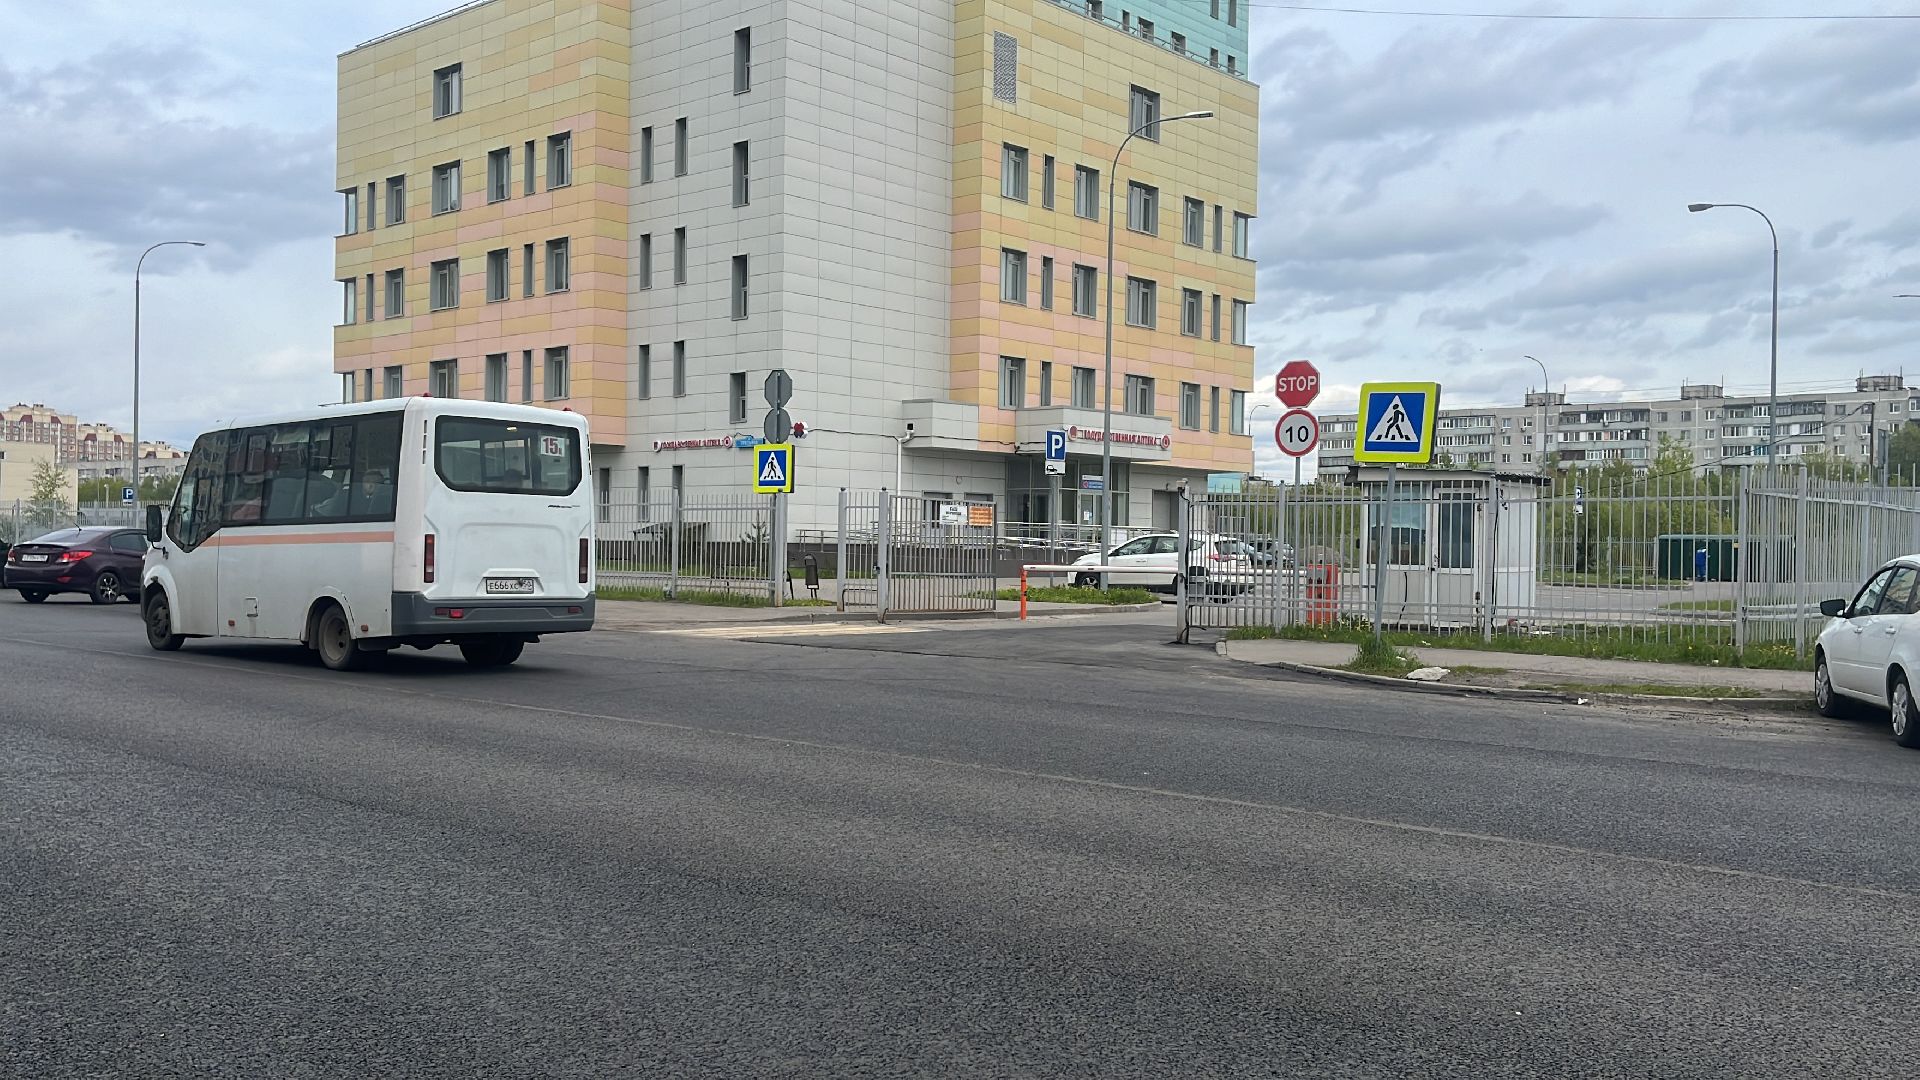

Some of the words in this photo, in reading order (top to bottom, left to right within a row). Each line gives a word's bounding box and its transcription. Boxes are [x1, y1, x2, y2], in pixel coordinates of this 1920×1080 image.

[1278, 375, 1317, 392] STOP
[1084, 430, 1136, 443] ГОСУДАСТВЕННАЯ
[1285, 425, 1309, 443] 10
[1051, 434, 1063, 458] P
[126, 489, 133, 499] P
